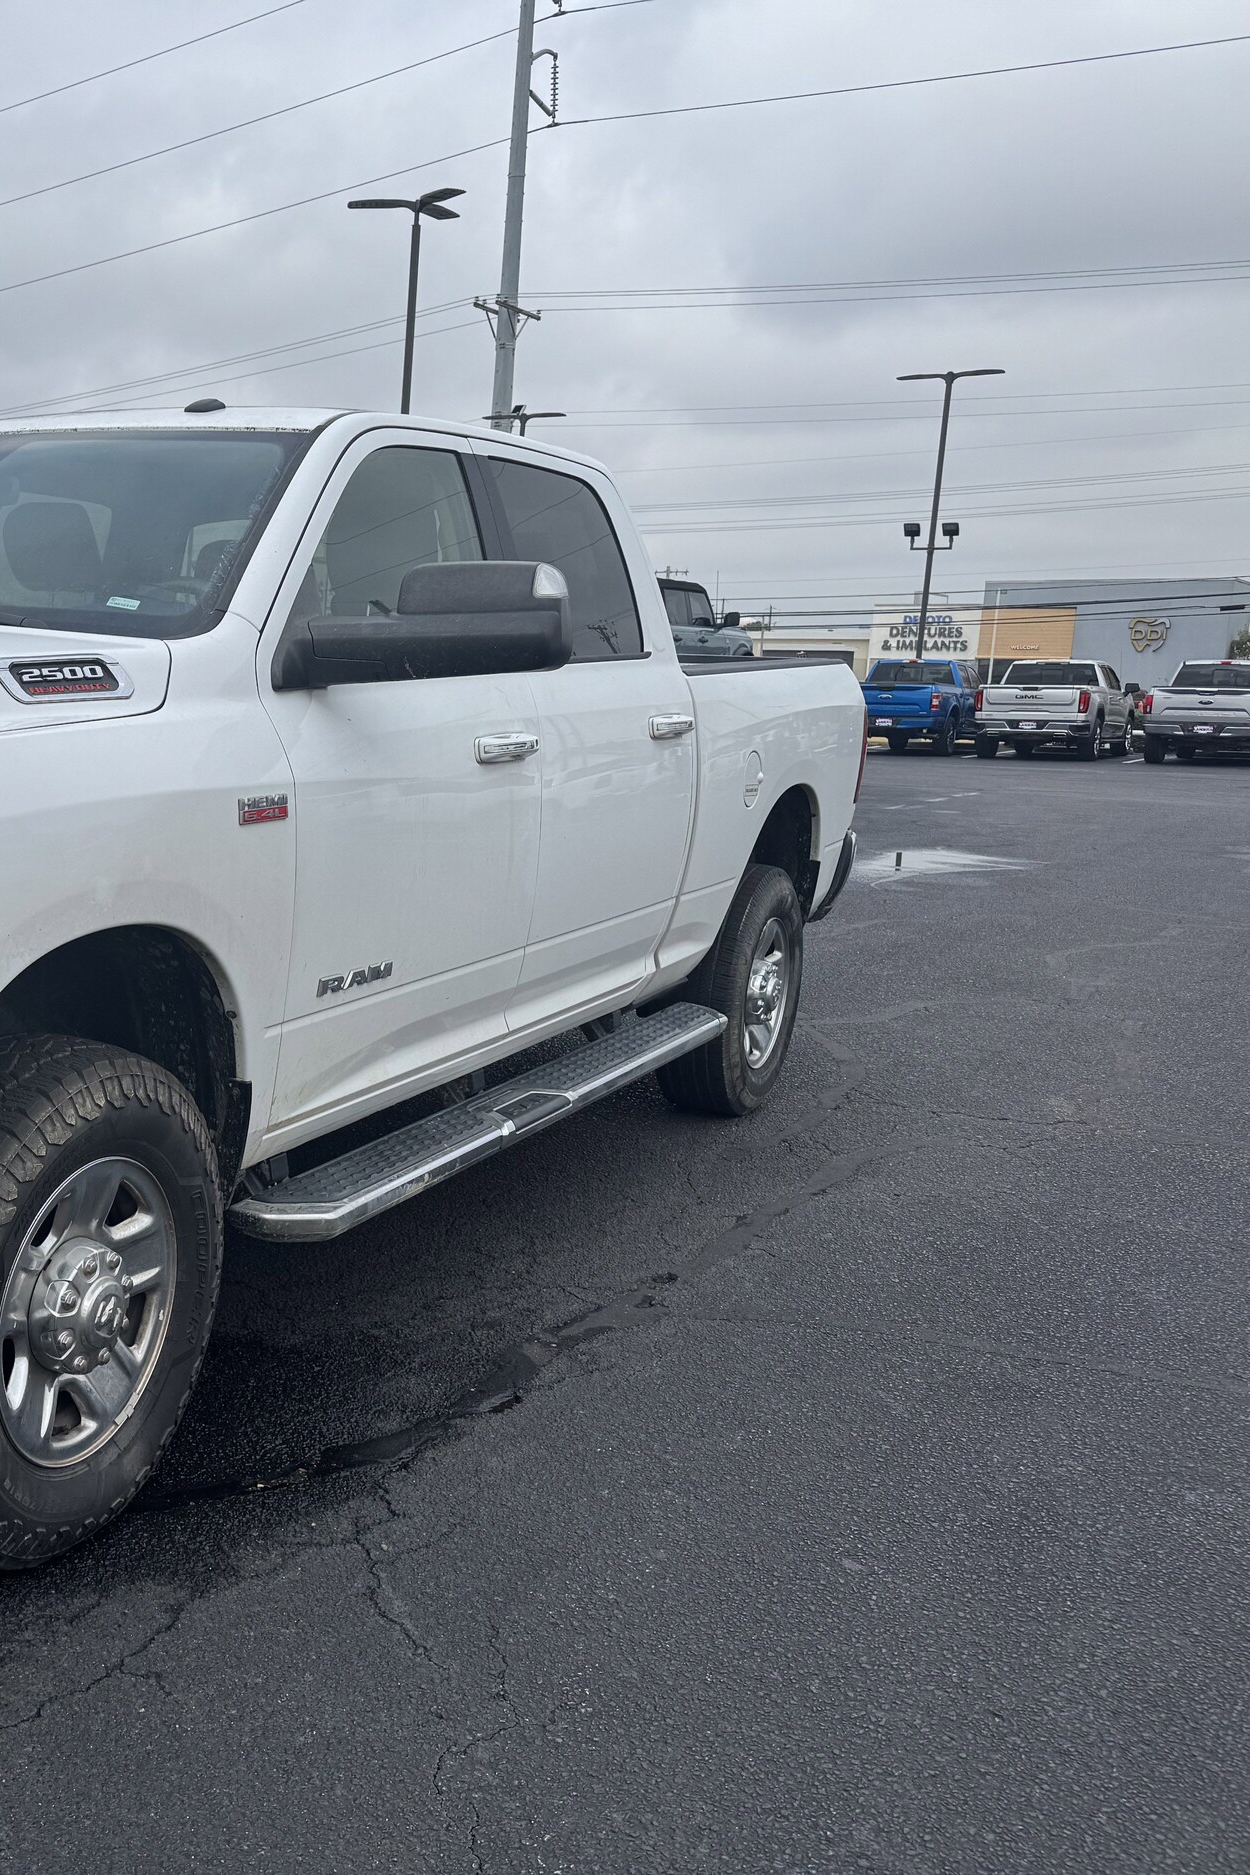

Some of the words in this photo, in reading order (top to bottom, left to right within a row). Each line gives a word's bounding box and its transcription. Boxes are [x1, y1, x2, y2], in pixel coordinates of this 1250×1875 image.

[903, 615, 953, 624] DEOTO
[889, 626, 963, 638] DENURES
[1131, 628, 1167, 641] DDI
[881, 639, 892, 651] &
[17, 665, 104, 683] 2500
[29, 686, 73, 696] HEAVY
[75, 682, 111, 692] DUTY
[238, 794, 288, 811] HEMI
[245, 809, 285, 822] 6.4L
[316, 959, 394, 997] RAM
